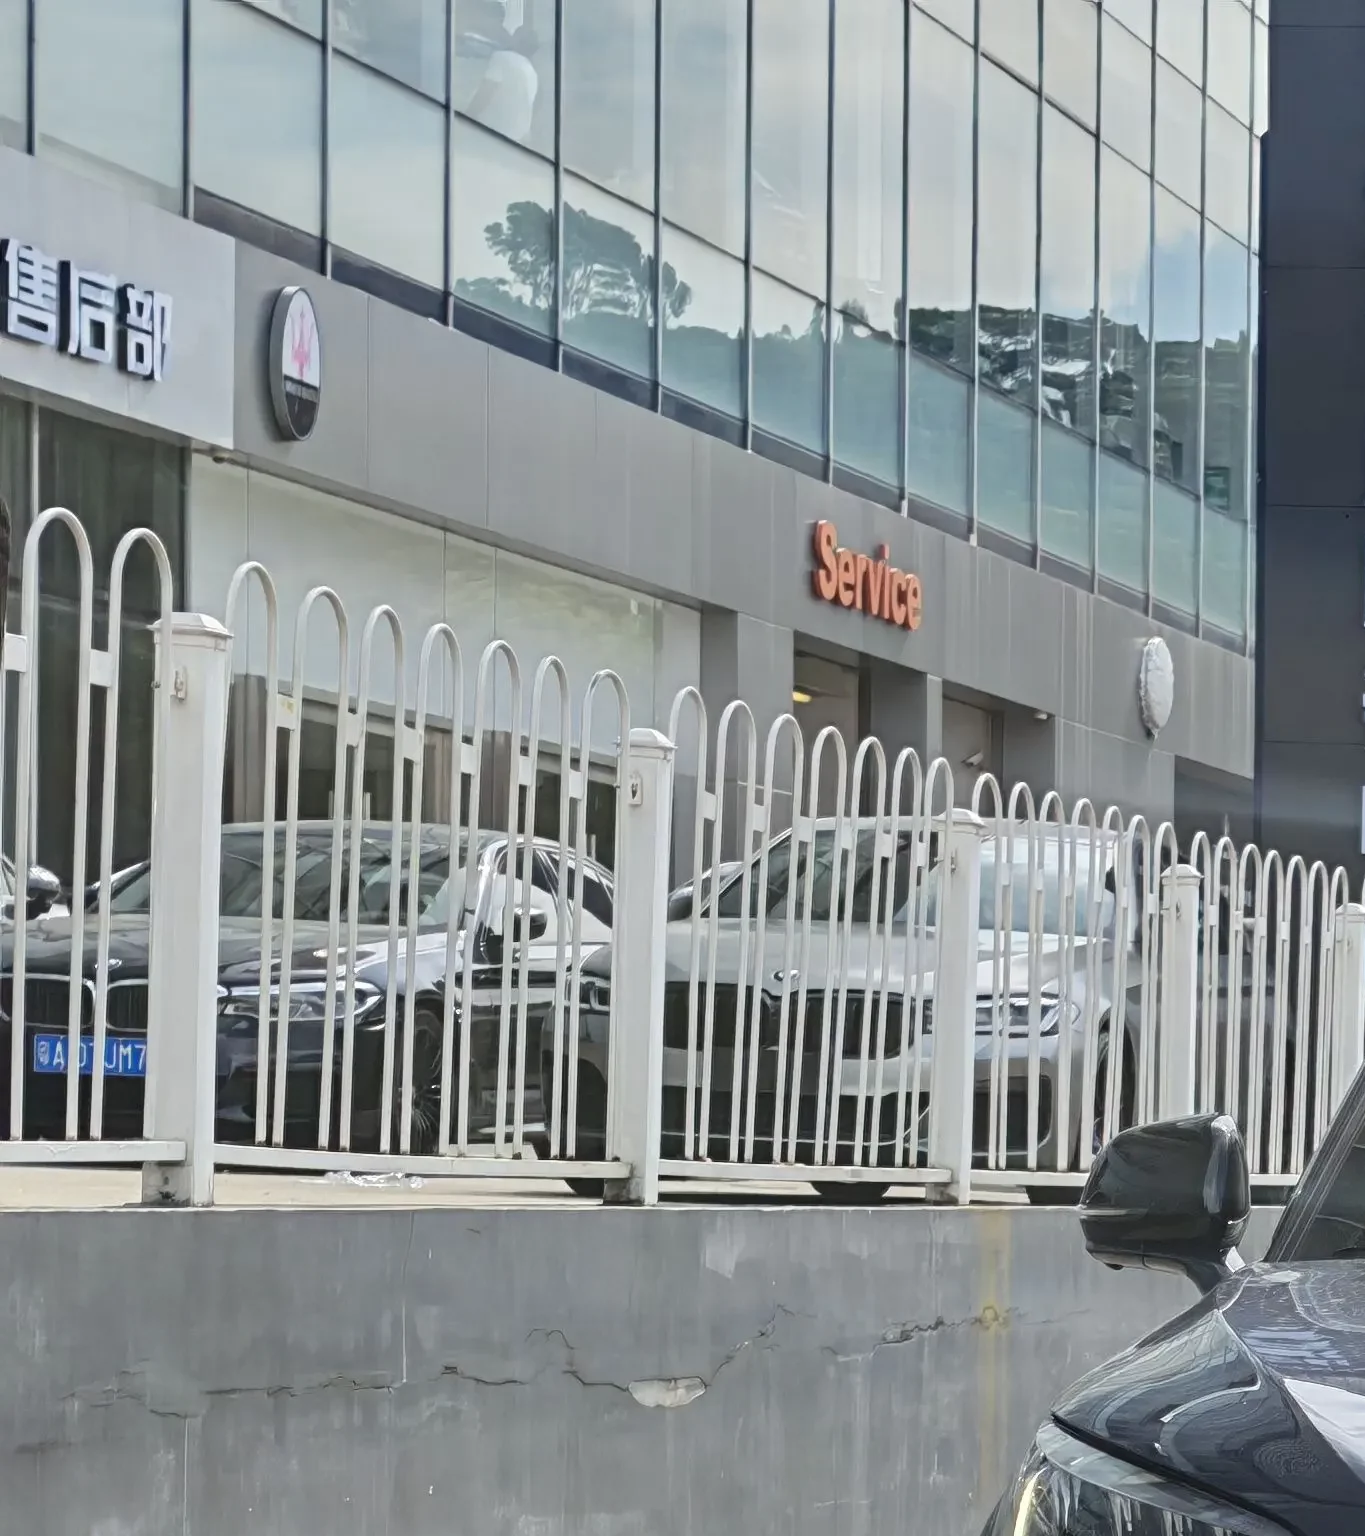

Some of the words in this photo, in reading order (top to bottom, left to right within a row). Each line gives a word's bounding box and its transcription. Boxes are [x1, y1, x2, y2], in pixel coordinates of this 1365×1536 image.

[3, 238, 174, 383] 售后部
[815, 520, 922, 630] Service
